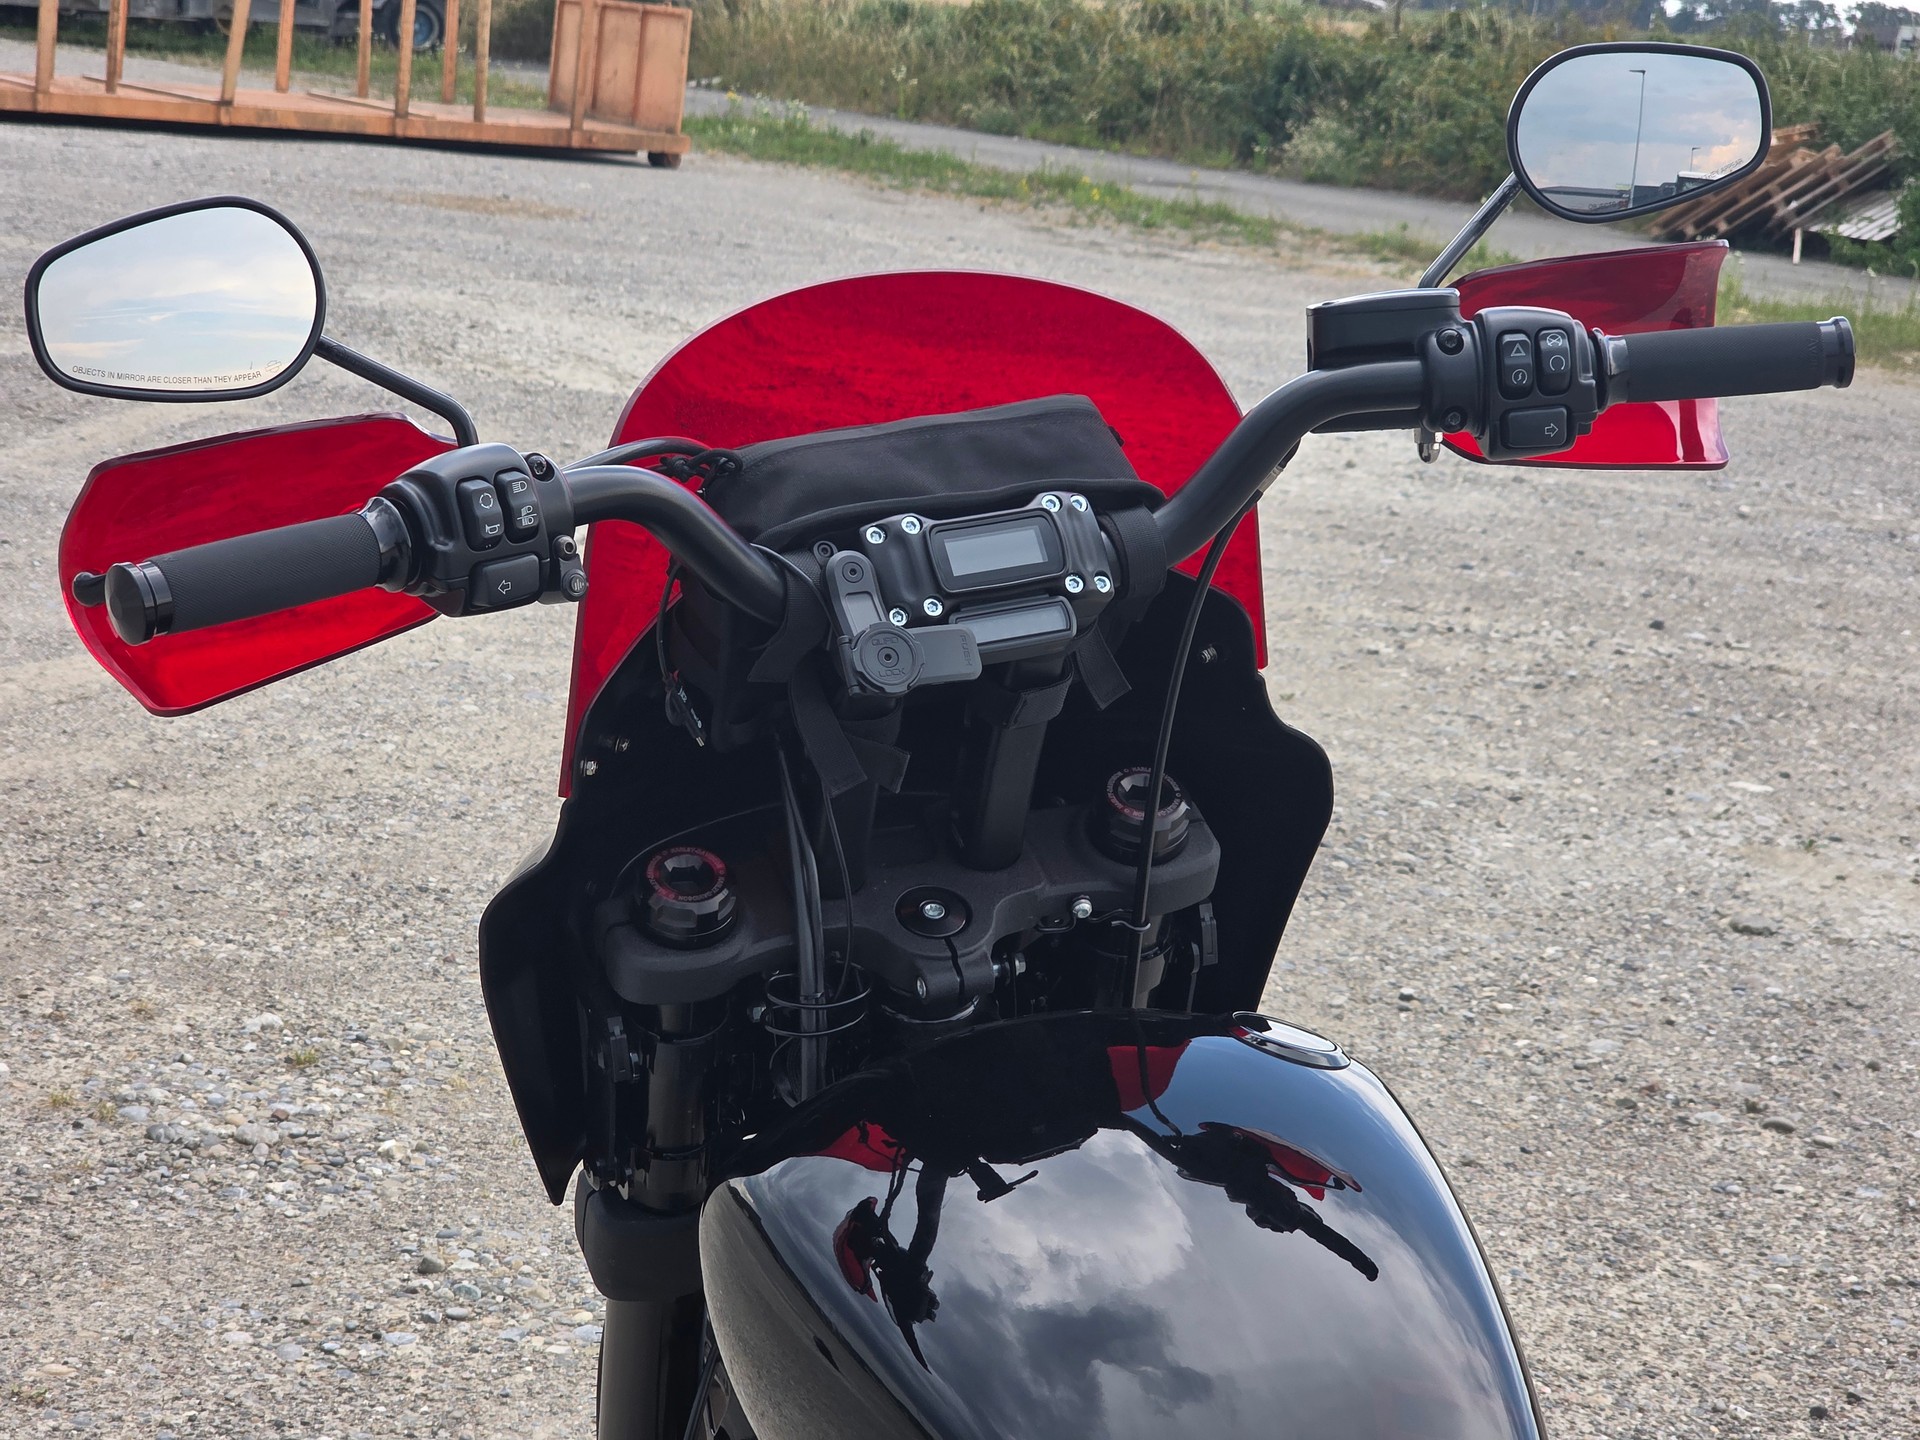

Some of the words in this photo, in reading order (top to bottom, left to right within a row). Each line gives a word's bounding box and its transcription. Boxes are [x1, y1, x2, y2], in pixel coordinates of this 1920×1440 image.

[1720, 158, 1744, 174] APPEAR
[72, 365, 106, 378] OBJECTS
[107, 371, 115, 379] IN
[116, 372, 146, 382] MIRROR
[147, 374, 162, 384] ARE
[163, 375, 192, 385] CLOSER
[194, 376, 213, 385] THAN
[213, 374, 232, 384] THEY
[233, 370, 262, 382] APPEAR
[872, 636, 899, 646] QUAD
[959, 634, 973, 666] PUSH
[878, 667, 906, 678] LOCK
